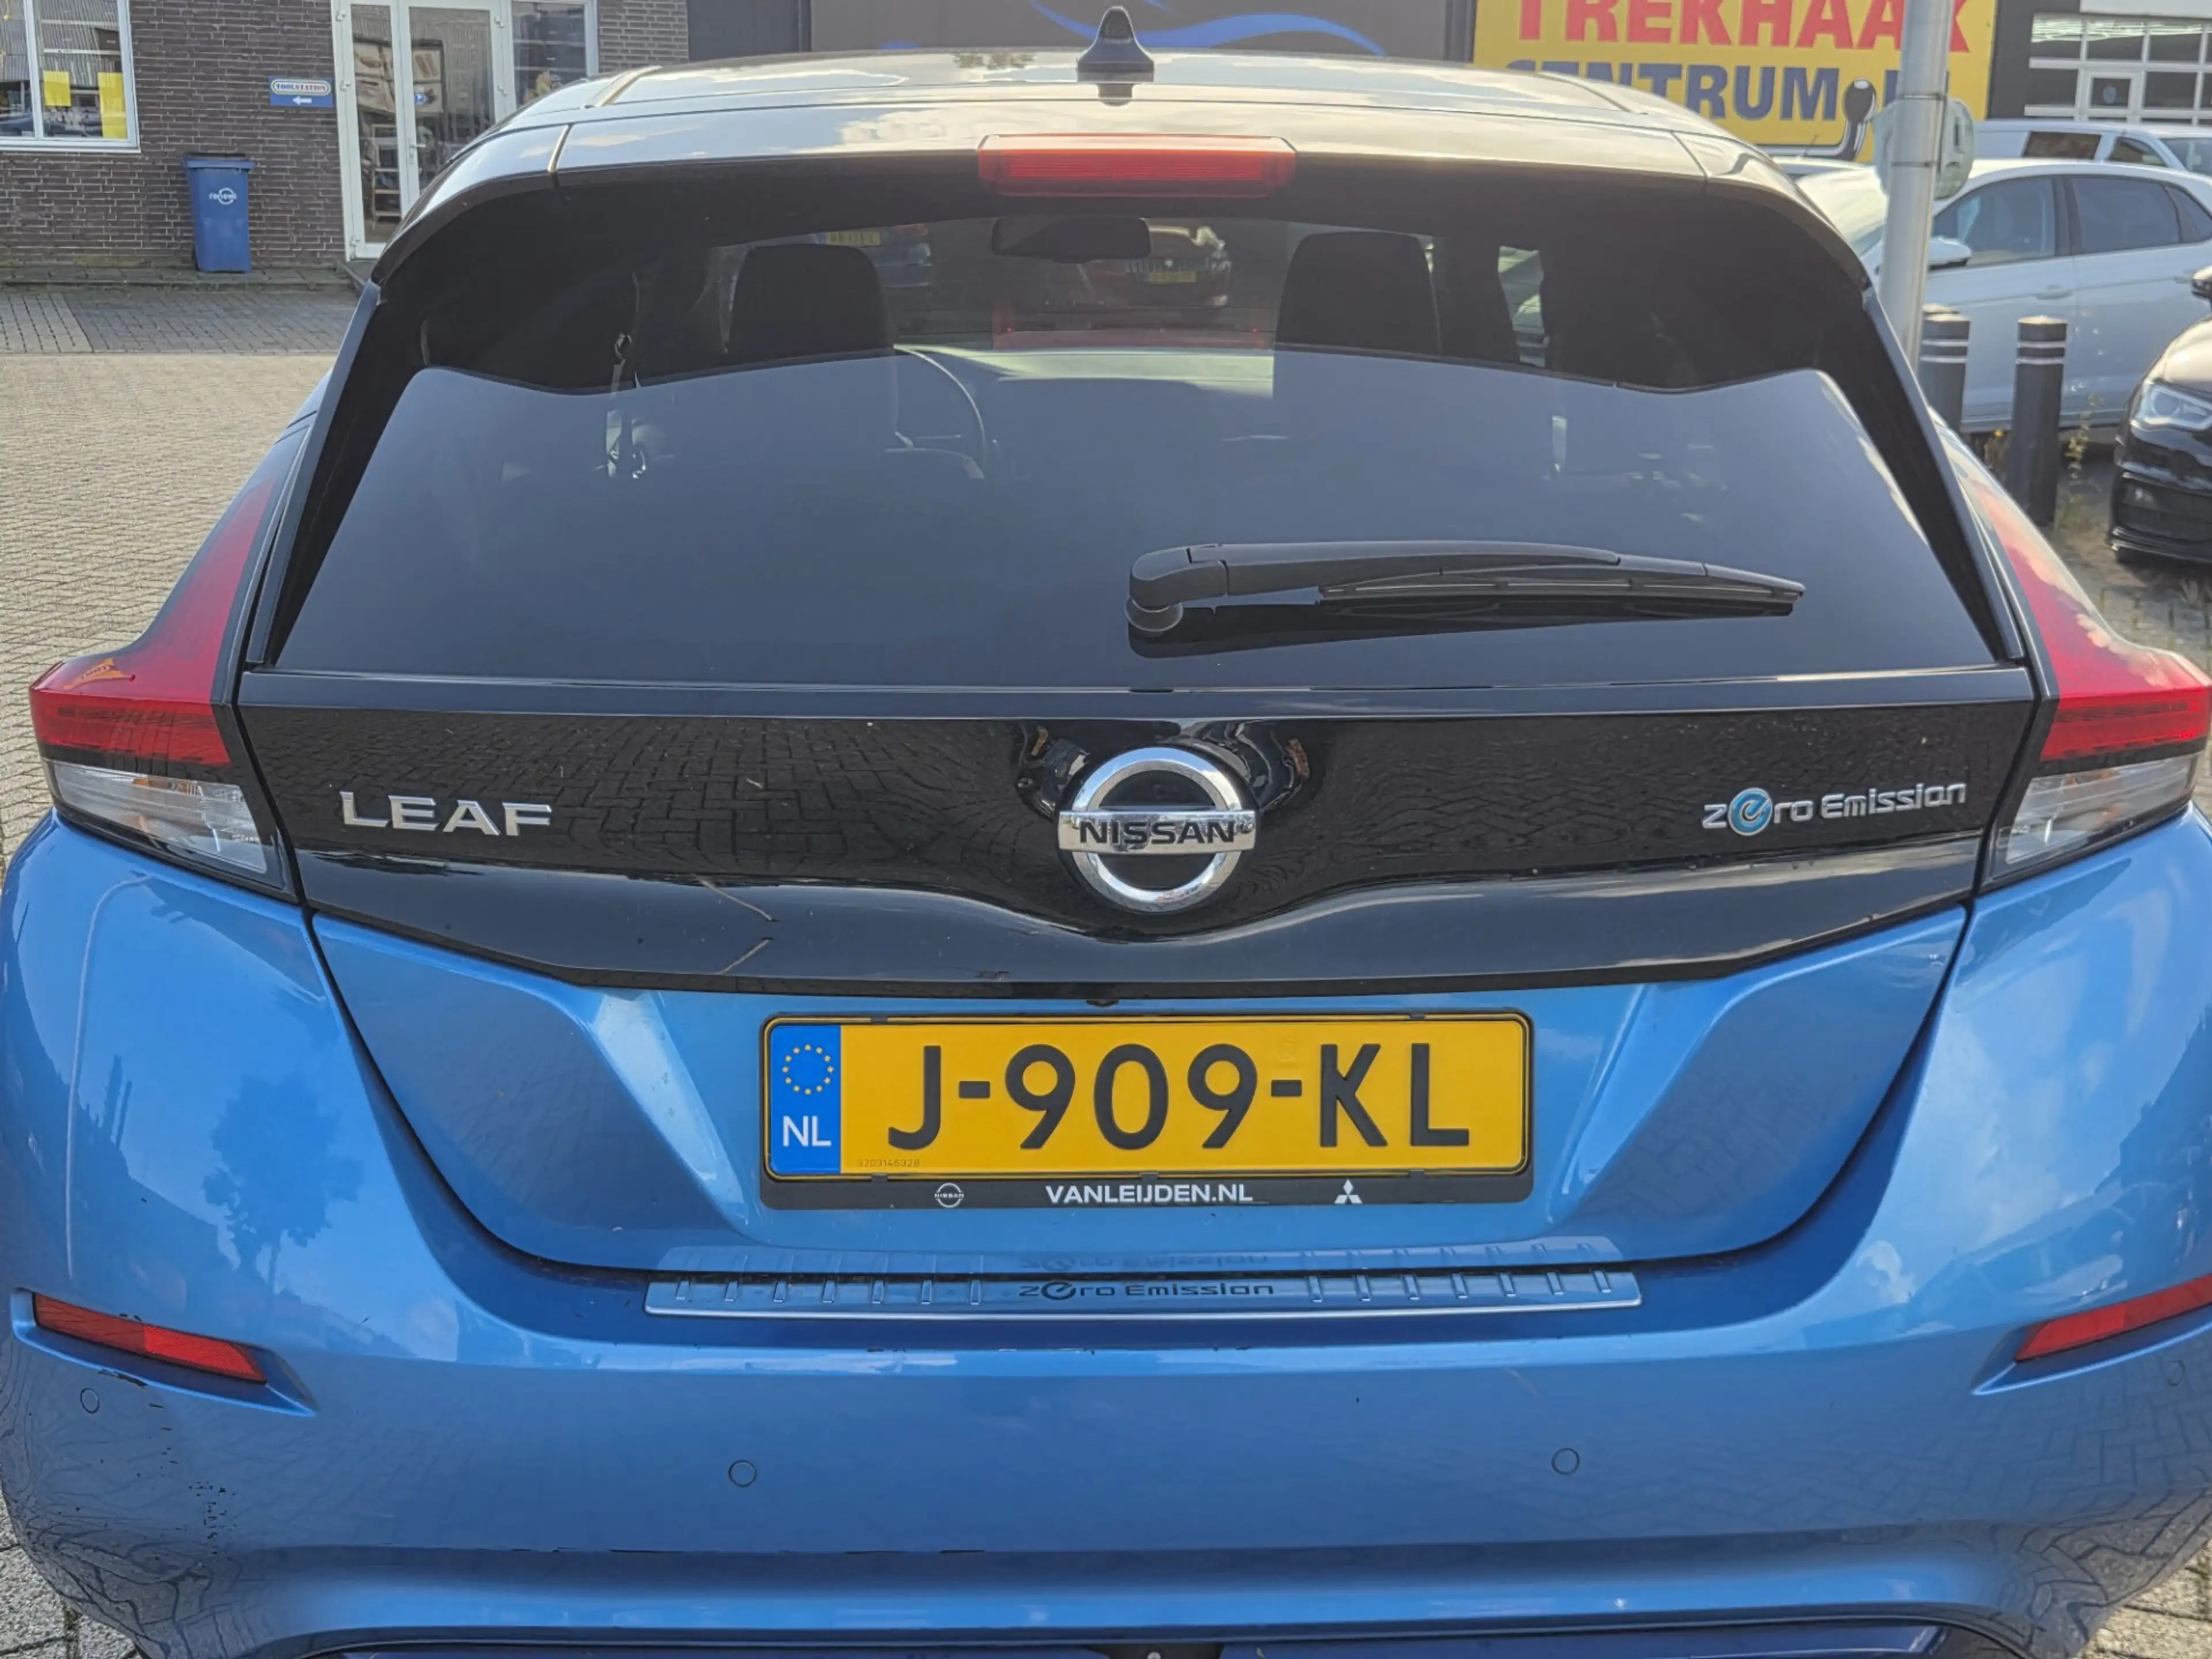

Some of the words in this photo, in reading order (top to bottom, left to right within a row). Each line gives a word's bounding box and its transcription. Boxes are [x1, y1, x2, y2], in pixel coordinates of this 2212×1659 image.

[276, 83, 327, 91] TOOLSTATION
[1506, 59, 1840, 121] TRUM
[339, 790, 552, 836] LEAF
[1821, 783, 1967, 819] Emission
[1078, 820, 1236, 845] NISSAN
[888, 1043, 1470, 1151] J-909-KL
[783, 1115, 832, 1147] NL
[1045, 1184, 1253, 1204] VANLEIJDEN.NL
[1125, 1282, 1274, 1296] Emission
